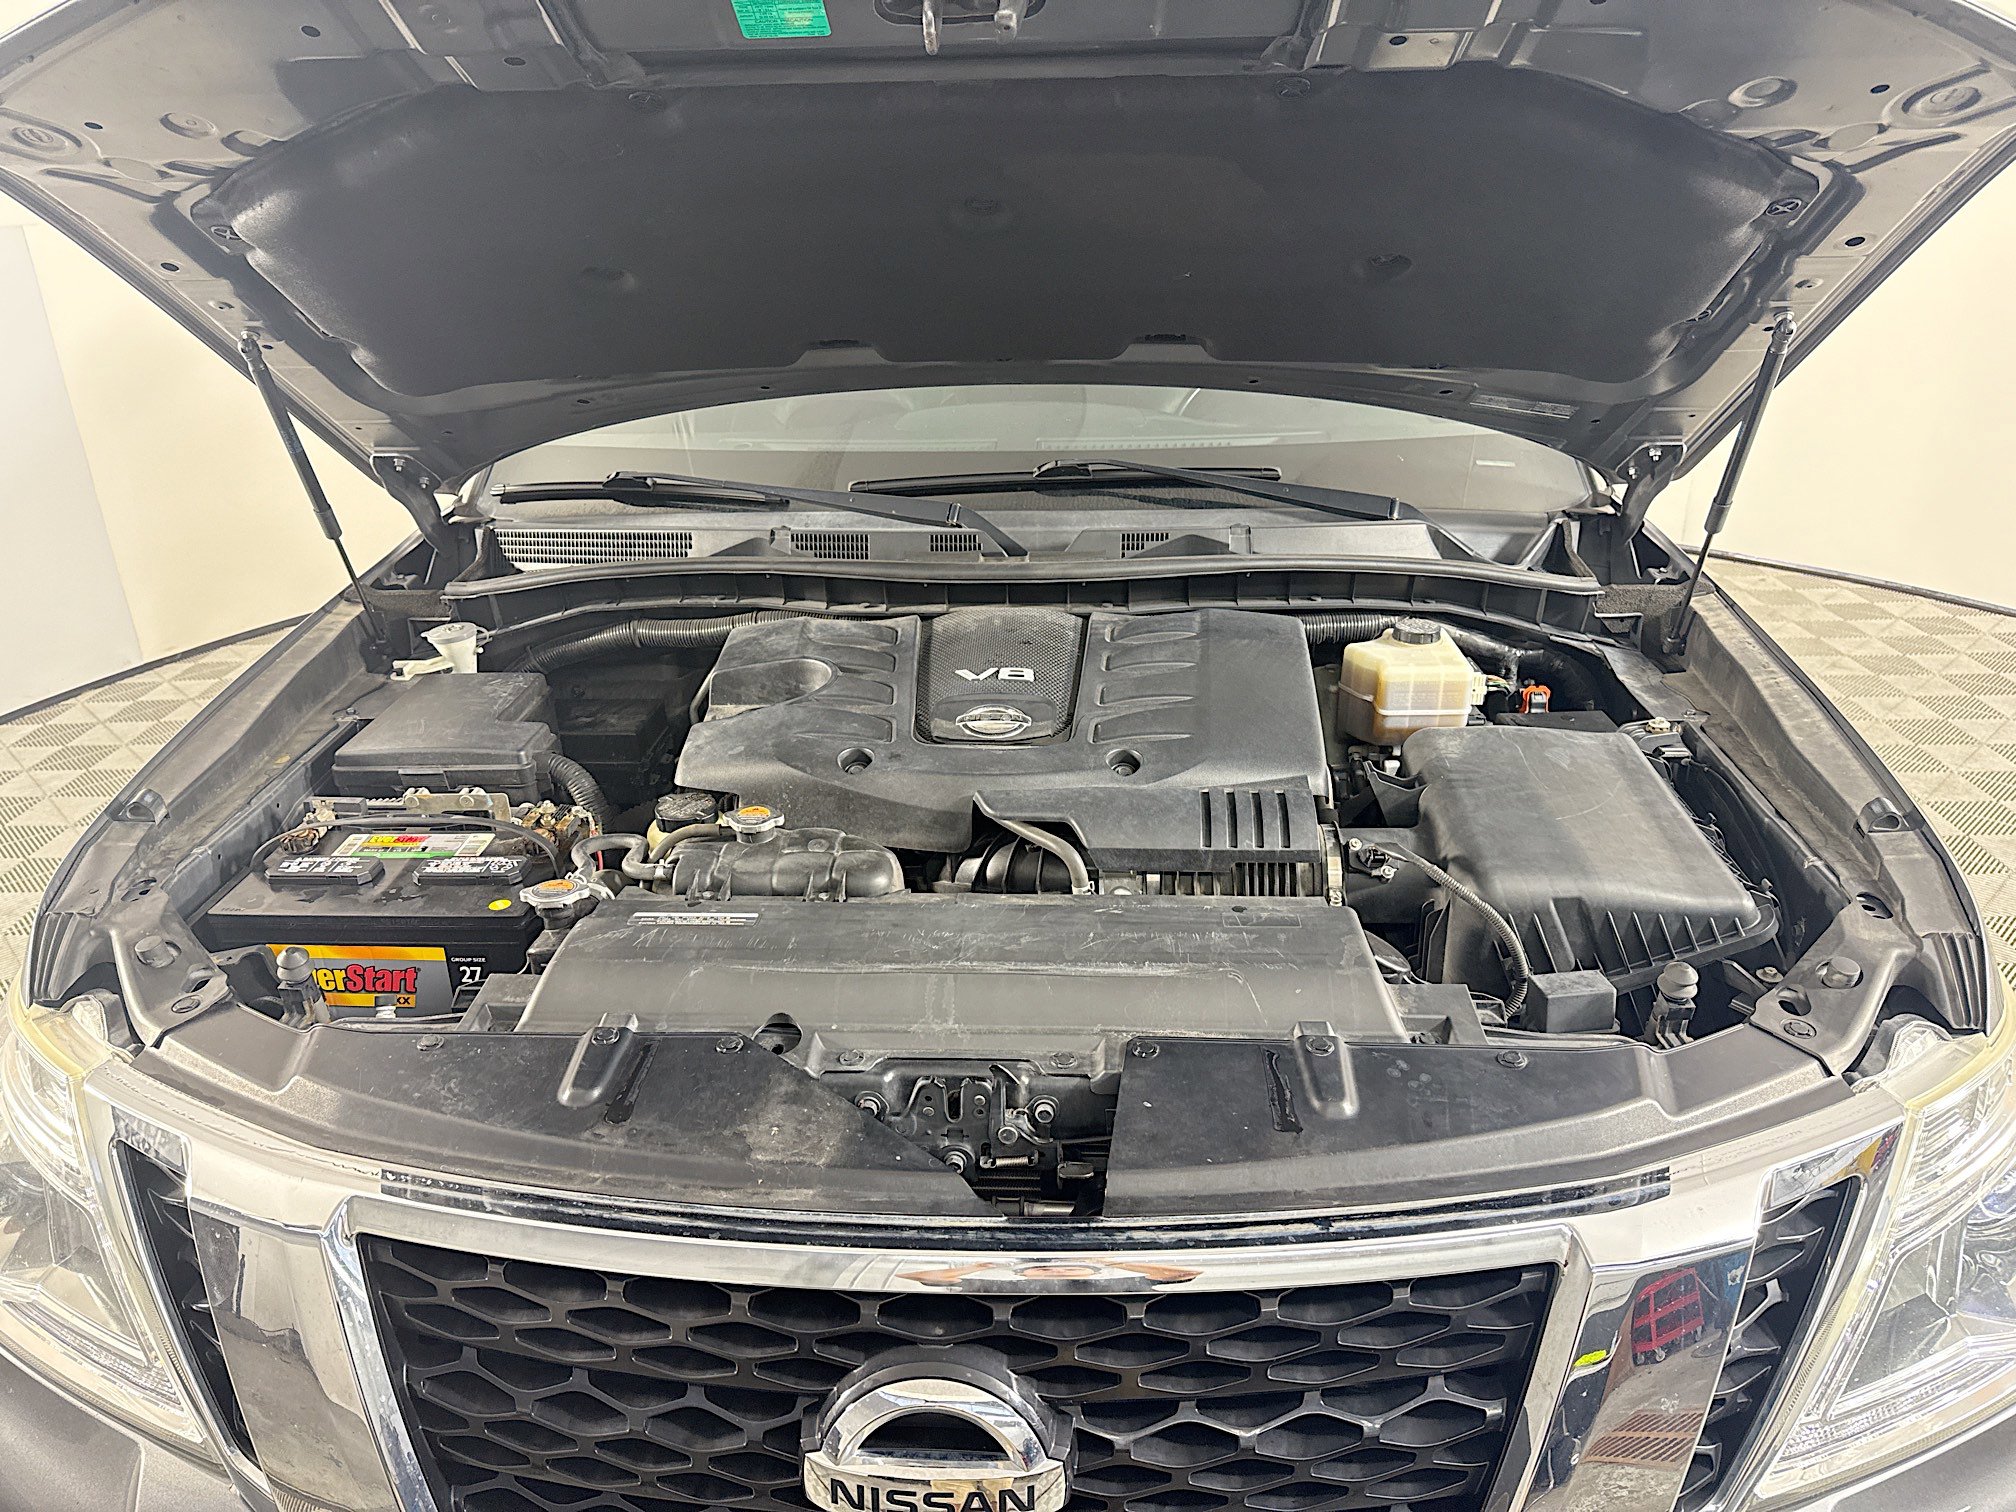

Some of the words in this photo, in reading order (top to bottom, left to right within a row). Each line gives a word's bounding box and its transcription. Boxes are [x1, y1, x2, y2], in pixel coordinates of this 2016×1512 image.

[954, 667, 1035, 682] V8
[311, 963, 418, 993] erStart
[459, 965, 482, 983] 27
[830, 1478, 1035, 1512] NISSAN
